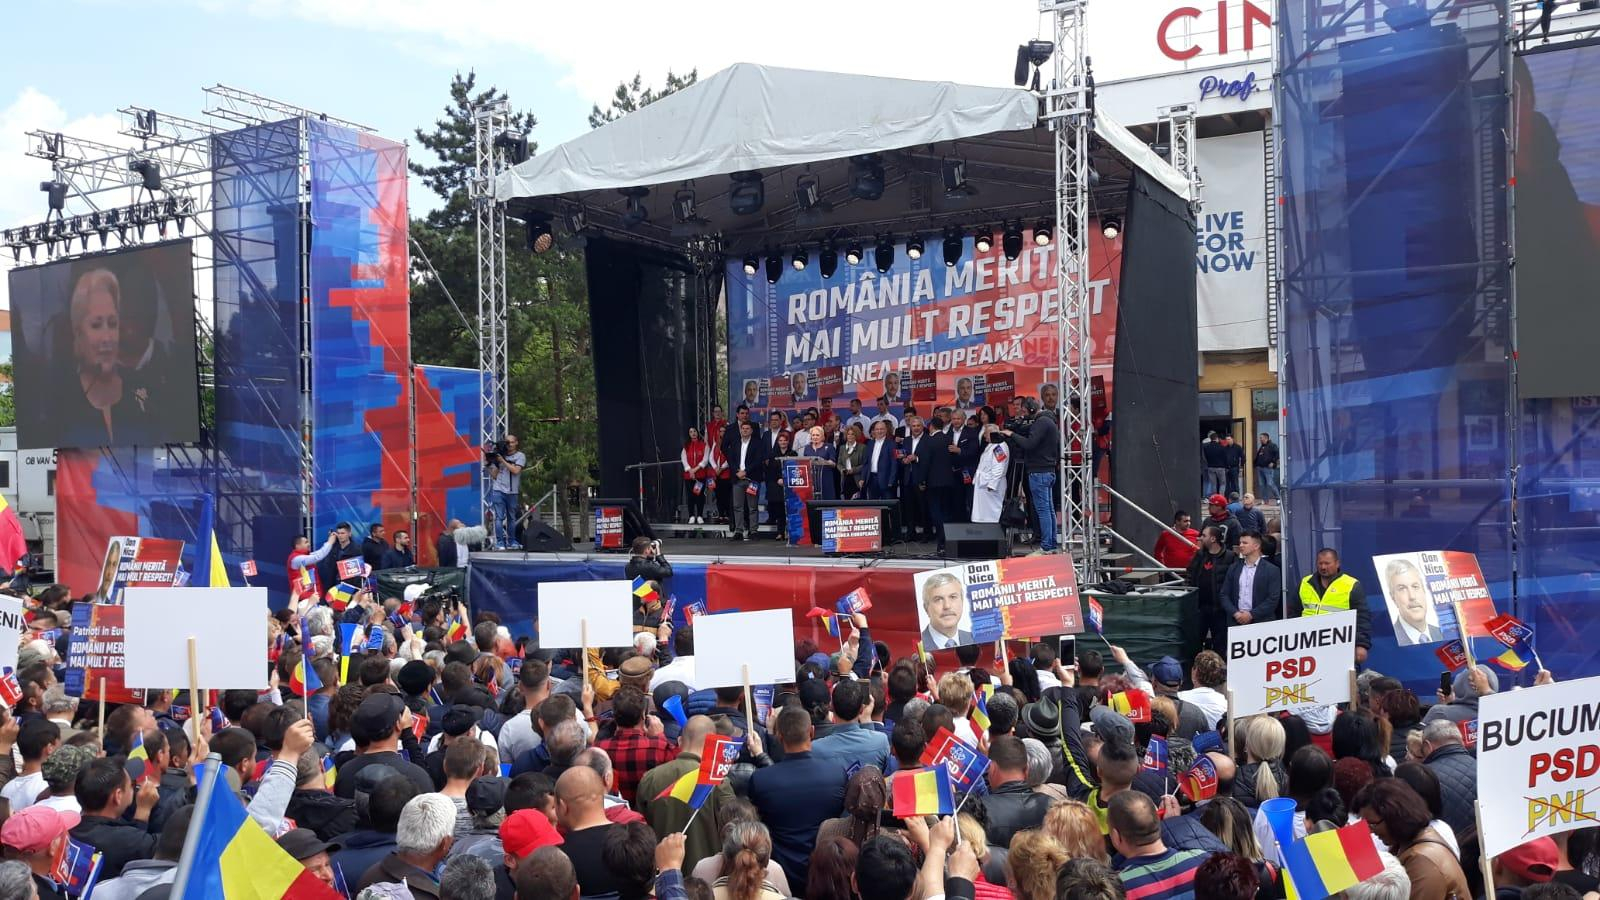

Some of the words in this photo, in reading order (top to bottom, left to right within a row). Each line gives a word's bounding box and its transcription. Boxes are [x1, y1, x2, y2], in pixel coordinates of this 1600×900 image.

[1199, 72, 1260, 102] Prof.
[788, 269, 935, 325] ROMÂNIA
[785, 327, 842, 365] MAI
[852, 309, 940, 354] MULT
[36, 456, 50, 465] VAN
[142, 560, 167, 571] MERITĂ
[967, 564, 990, 574] Dan
[1421, 553, 1438, 563] Dan
[1424, 563, 1444, 574] Nica
[968, 573, 994, 584] Nica
[971, 584, 1015, 600] ROMÂNII
[1017, 575, 1057, 592] MERITĂ
[973, 600, 993, 611] MAI
[995, 593, 1022, 607] MULT
[1024, 586, 1073, 602] RESPECT!
[1432, 592, 1450, 605] MAI
[0, 610, 18, 630] NI
[1231, 625, 1353, 660] BUCIUMENI
[1499, 631, 1517, 644] PSD
[70, 655, 85, 667] MAI
[86, 655, 108, 667] MULT
[1266, 656, 1316, 681] PSD
[1265, 683, 1315, 708] PNL
[1127, 709, 1138, 717] SD
[1482, 702, 1600, 752] BUCIUM
[1528, 744, 1600, 788] PSD
[1528, 789, 1597, 832] PNL
